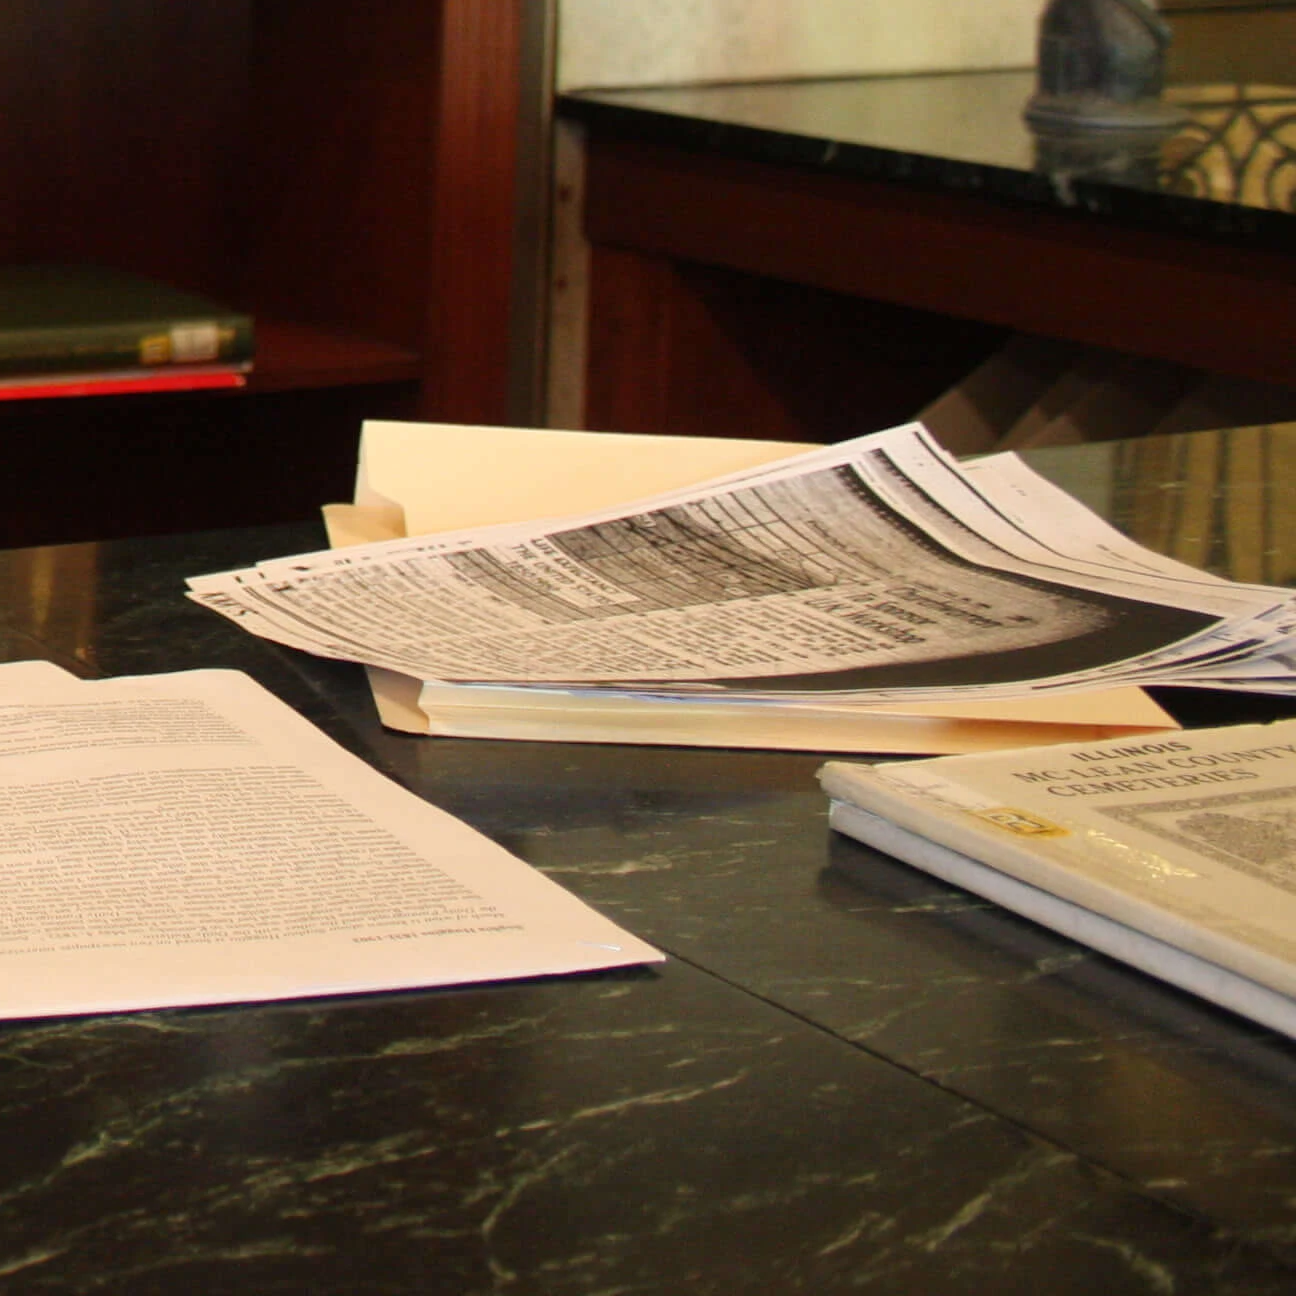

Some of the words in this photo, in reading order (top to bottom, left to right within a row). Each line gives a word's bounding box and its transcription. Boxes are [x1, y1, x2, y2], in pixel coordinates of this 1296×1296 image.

[1070, 741, 1192, 762] ILLINOIS
[1076, 759, 1166, 780] LEAN
[1168, 744, 1296, 769] COUNTY
[1047, 768, 1261, 798] CEMETERIES
